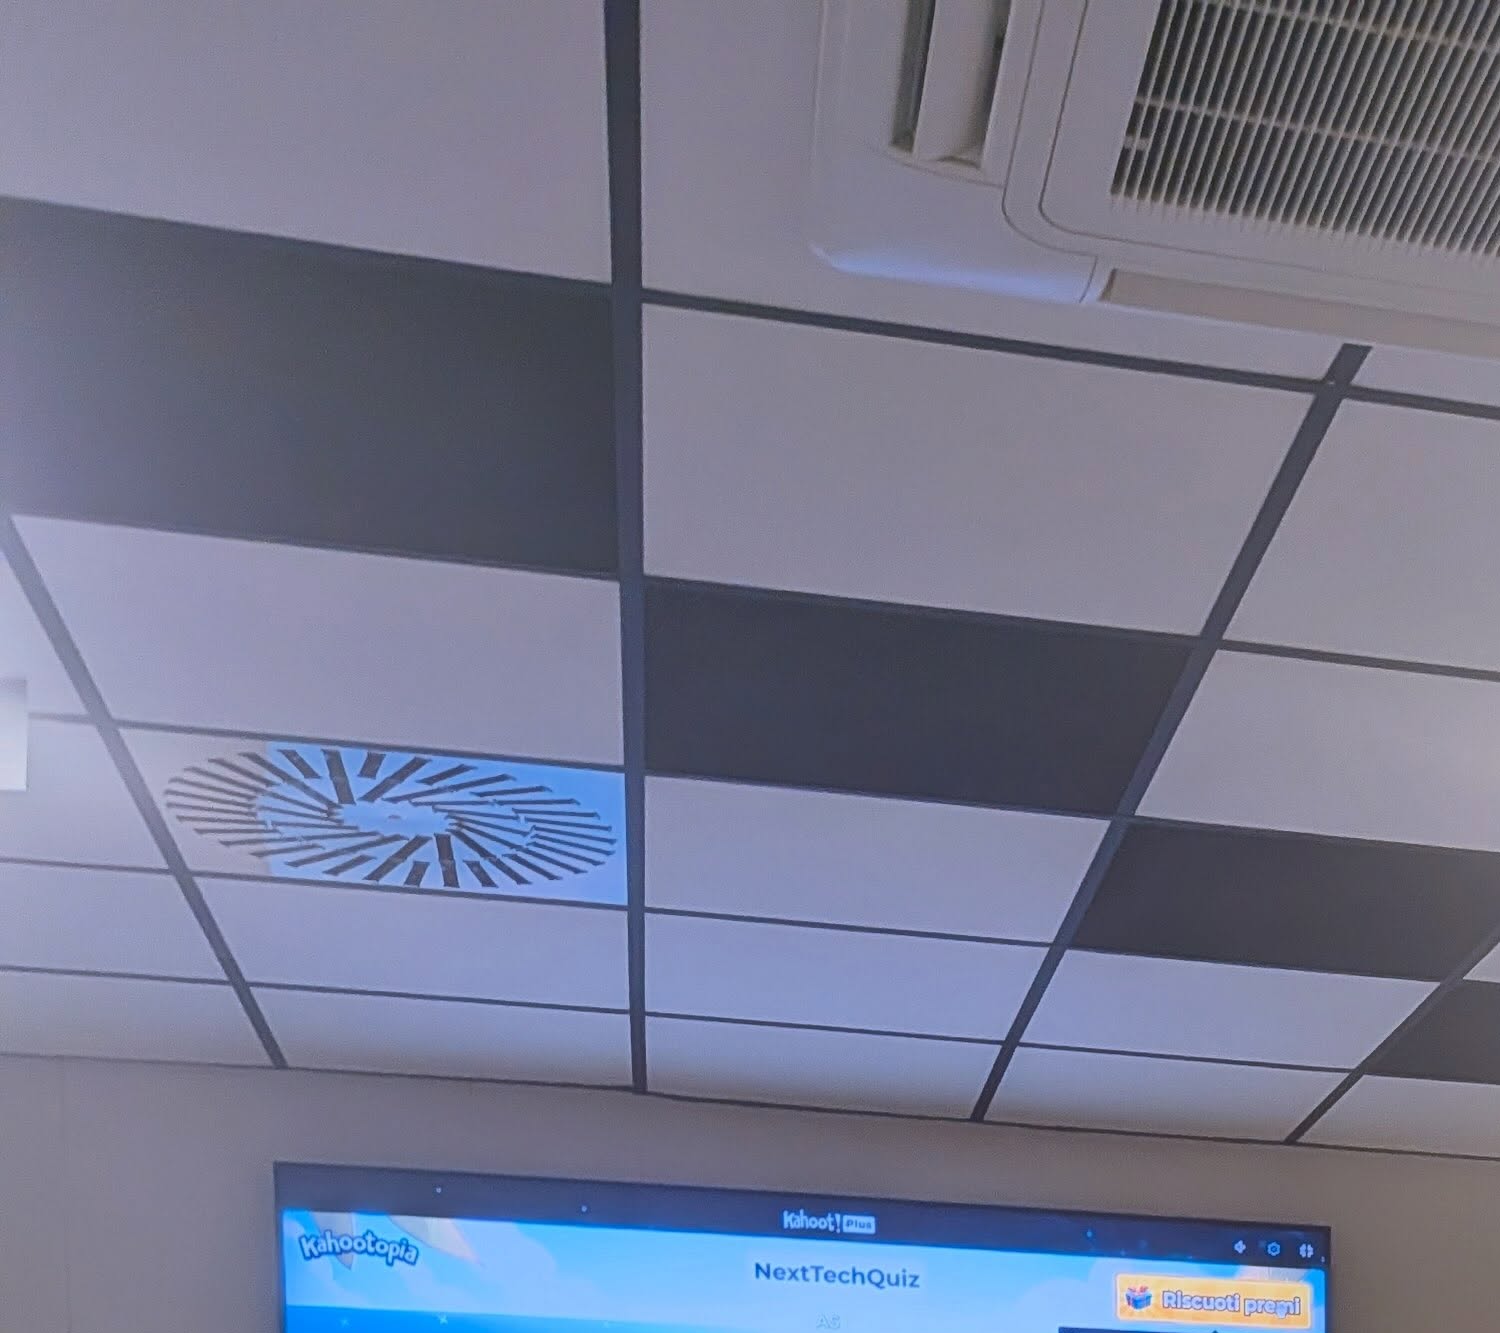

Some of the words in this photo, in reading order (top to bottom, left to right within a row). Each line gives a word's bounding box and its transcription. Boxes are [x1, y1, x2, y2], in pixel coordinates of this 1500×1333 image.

[783, 1209, 842, 1234] Kahoot!
[845, 1218, 873, 1230] Plus
[300, 1228, 420, 1267] Kahootopia
[754, 1261, 921, 1290] NextTechQuiz
[1162, 1290, 1241, 1312] Riscuoti
[1243, 1297, 1302, 1317] premi
